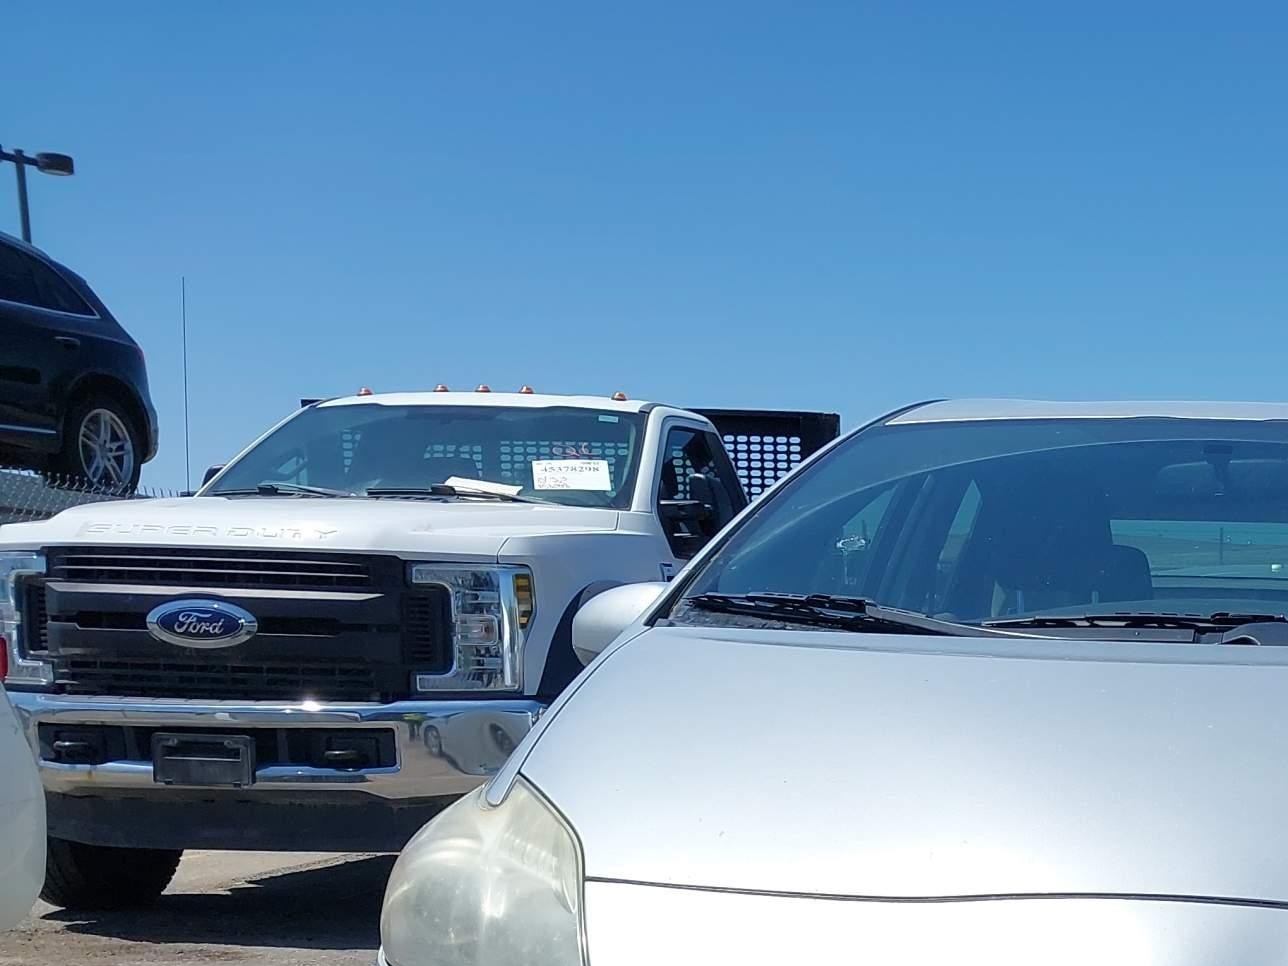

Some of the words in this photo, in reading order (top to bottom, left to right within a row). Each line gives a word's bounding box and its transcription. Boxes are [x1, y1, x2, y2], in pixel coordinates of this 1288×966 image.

[85, 522, 218, 537] SUPER
[226, 526, 338, 540] DUTY
[174, 611, 225, 634] Ford
